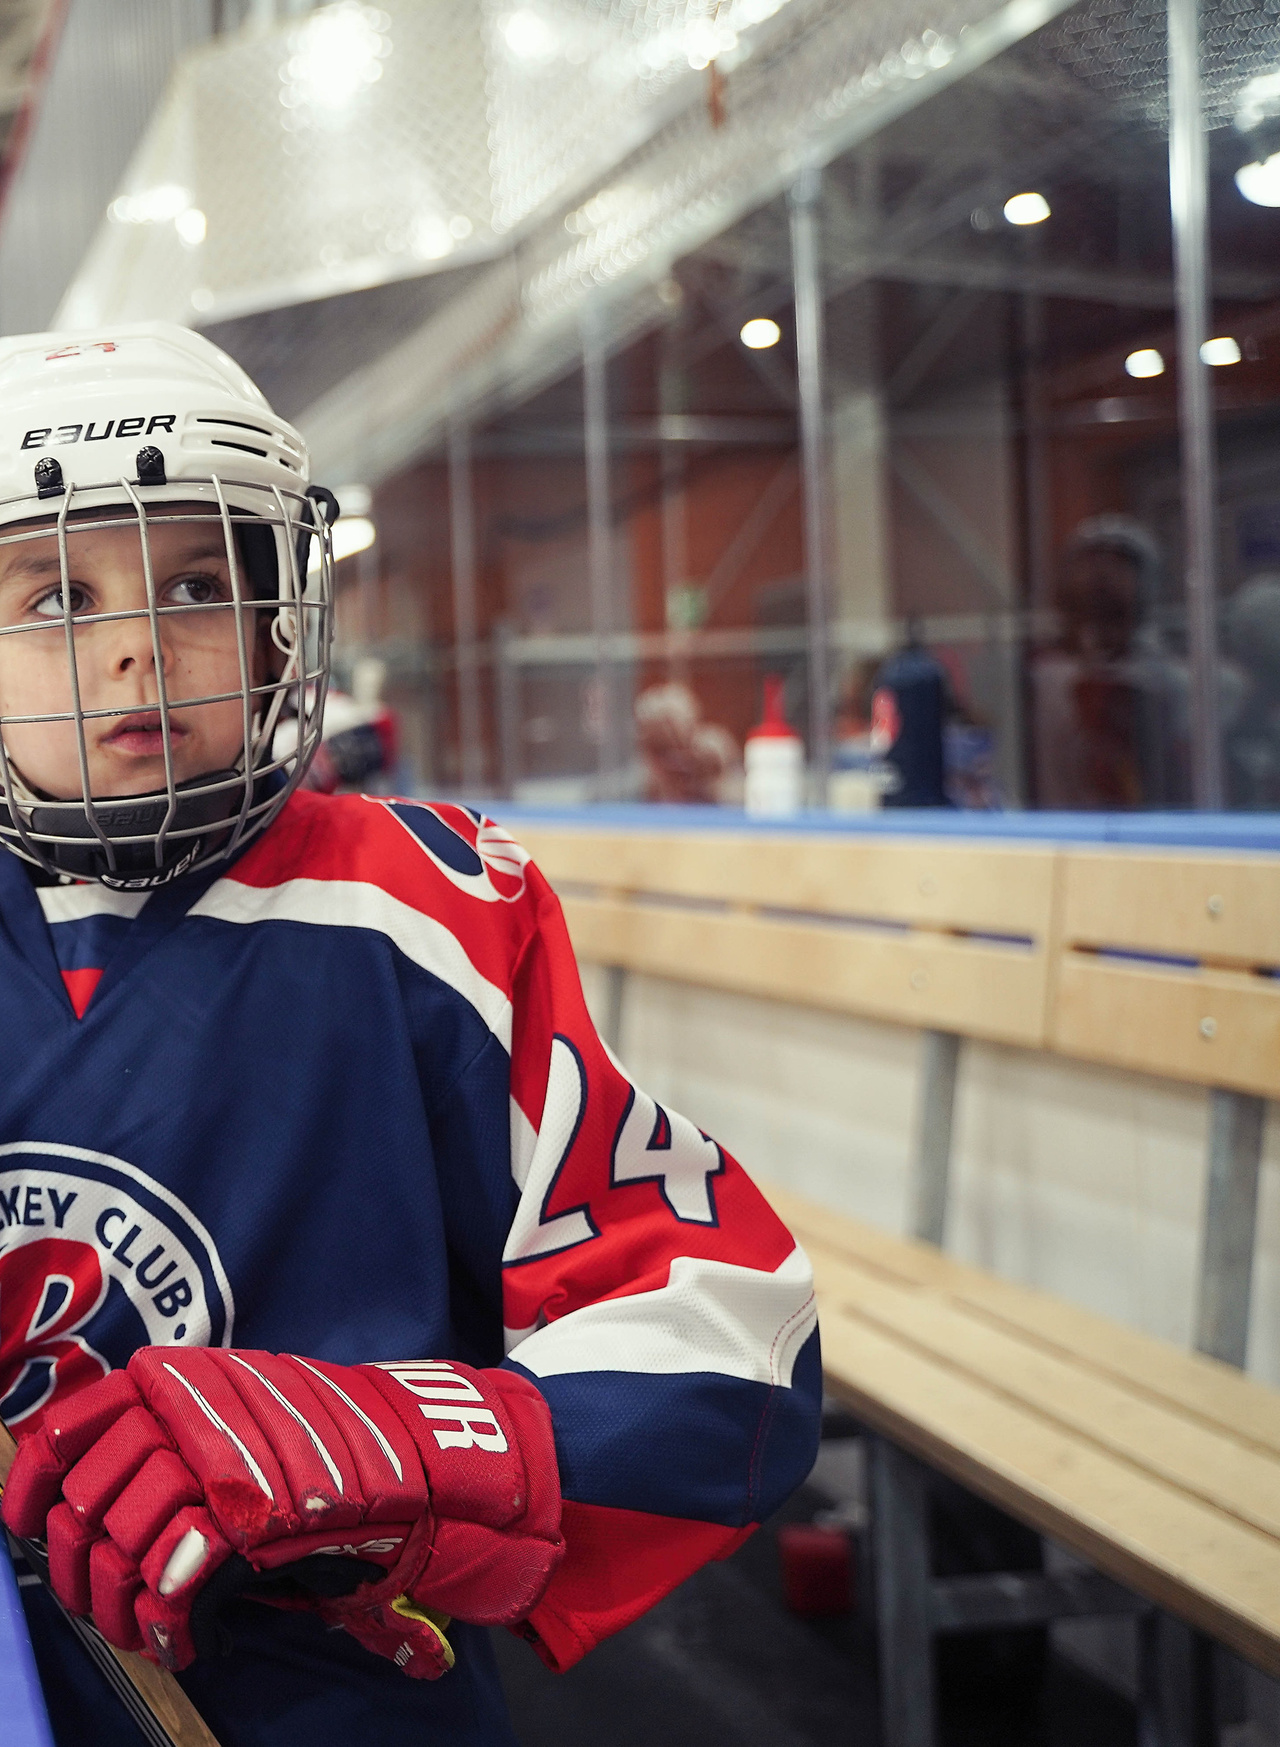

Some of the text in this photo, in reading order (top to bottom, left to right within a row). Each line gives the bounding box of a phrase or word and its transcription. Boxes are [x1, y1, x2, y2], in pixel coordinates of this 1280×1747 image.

[20, 414, 177, 450] BAUER
[502, 1033, 726, 1267] 24
[95, 1207, 193, 1318] CLUB
